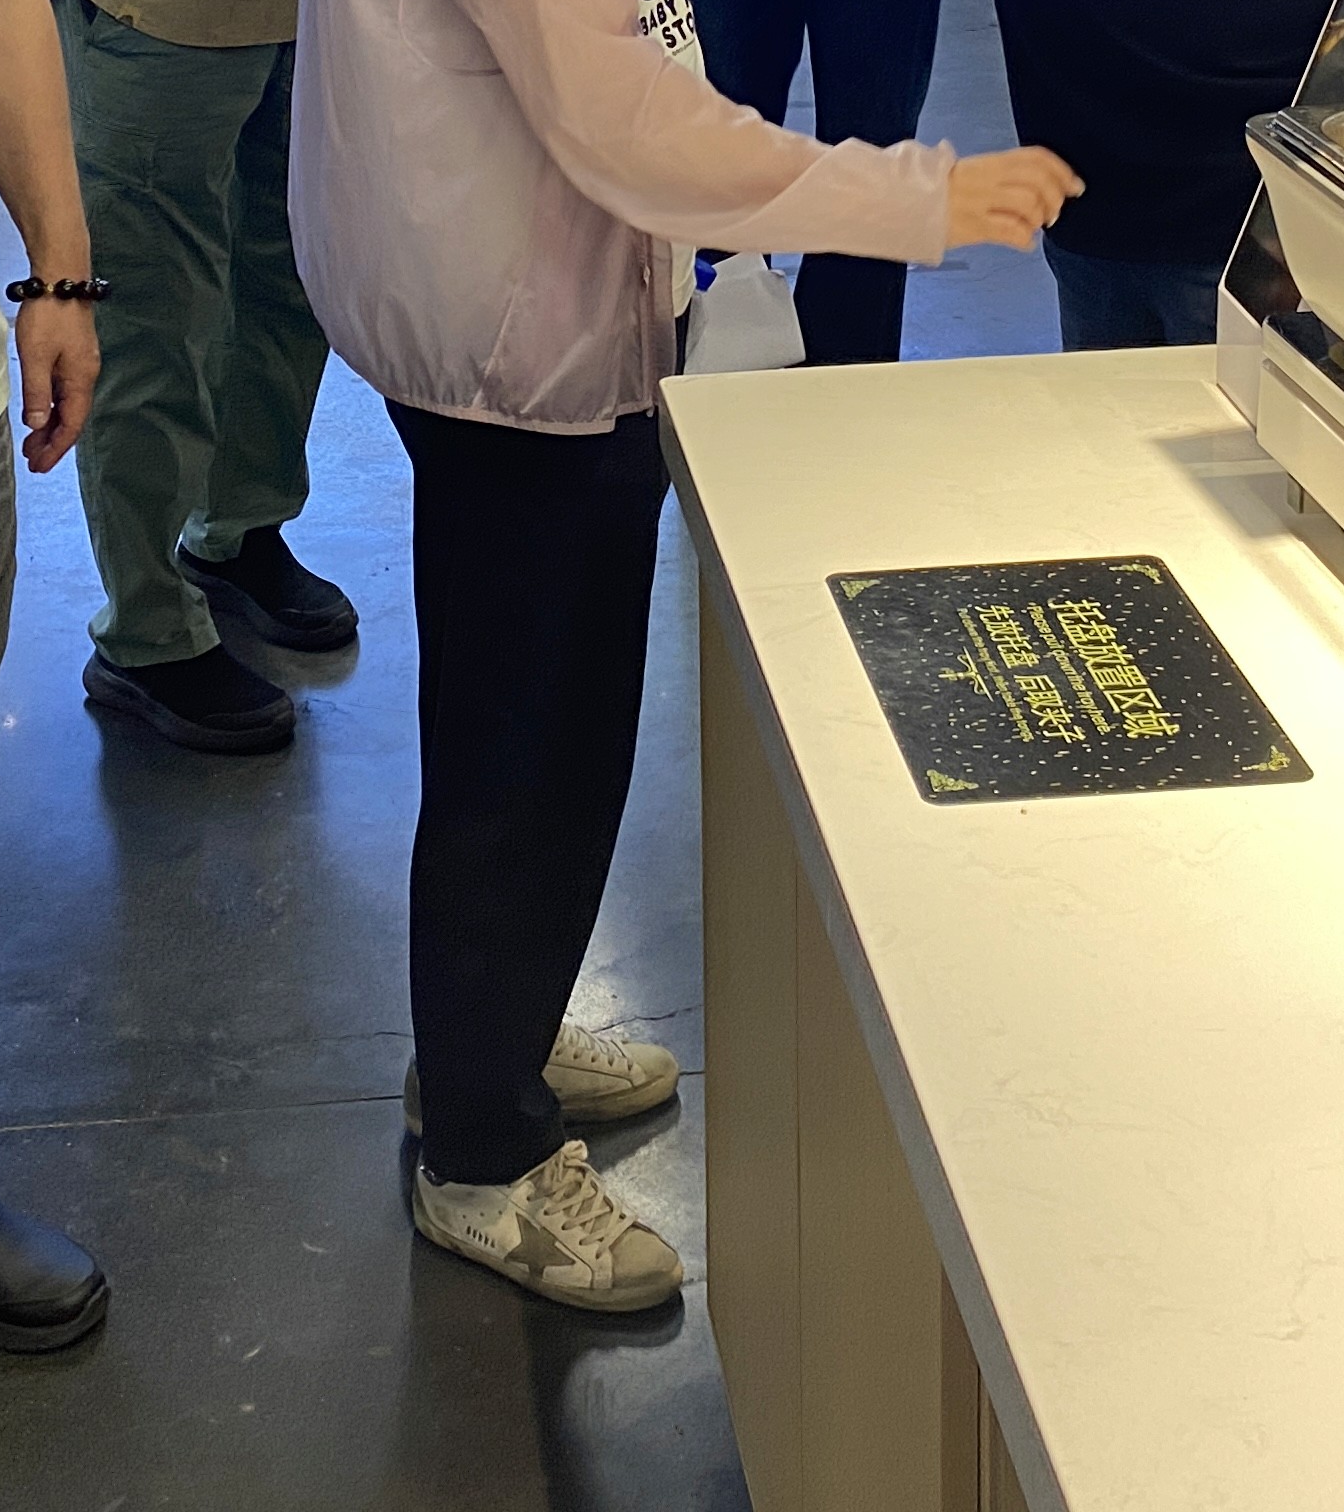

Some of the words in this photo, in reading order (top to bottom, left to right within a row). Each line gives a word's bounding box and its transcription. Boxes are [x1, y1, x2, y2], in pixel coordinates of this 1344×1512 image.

[1027, 604, 1052, 634] Please
[1044, 632, 1066, 650] put
[975, 604, 1040, 668] 先放托盘
[1013, 673, 1086, 743] 后取夹子
[1048, 599, 1181, 738] 托盘放置区域
[1051, 650, 1073, 676] down
[1075, 690, 1100, 710] tray
[1088, 708, 1112, 735] here.
